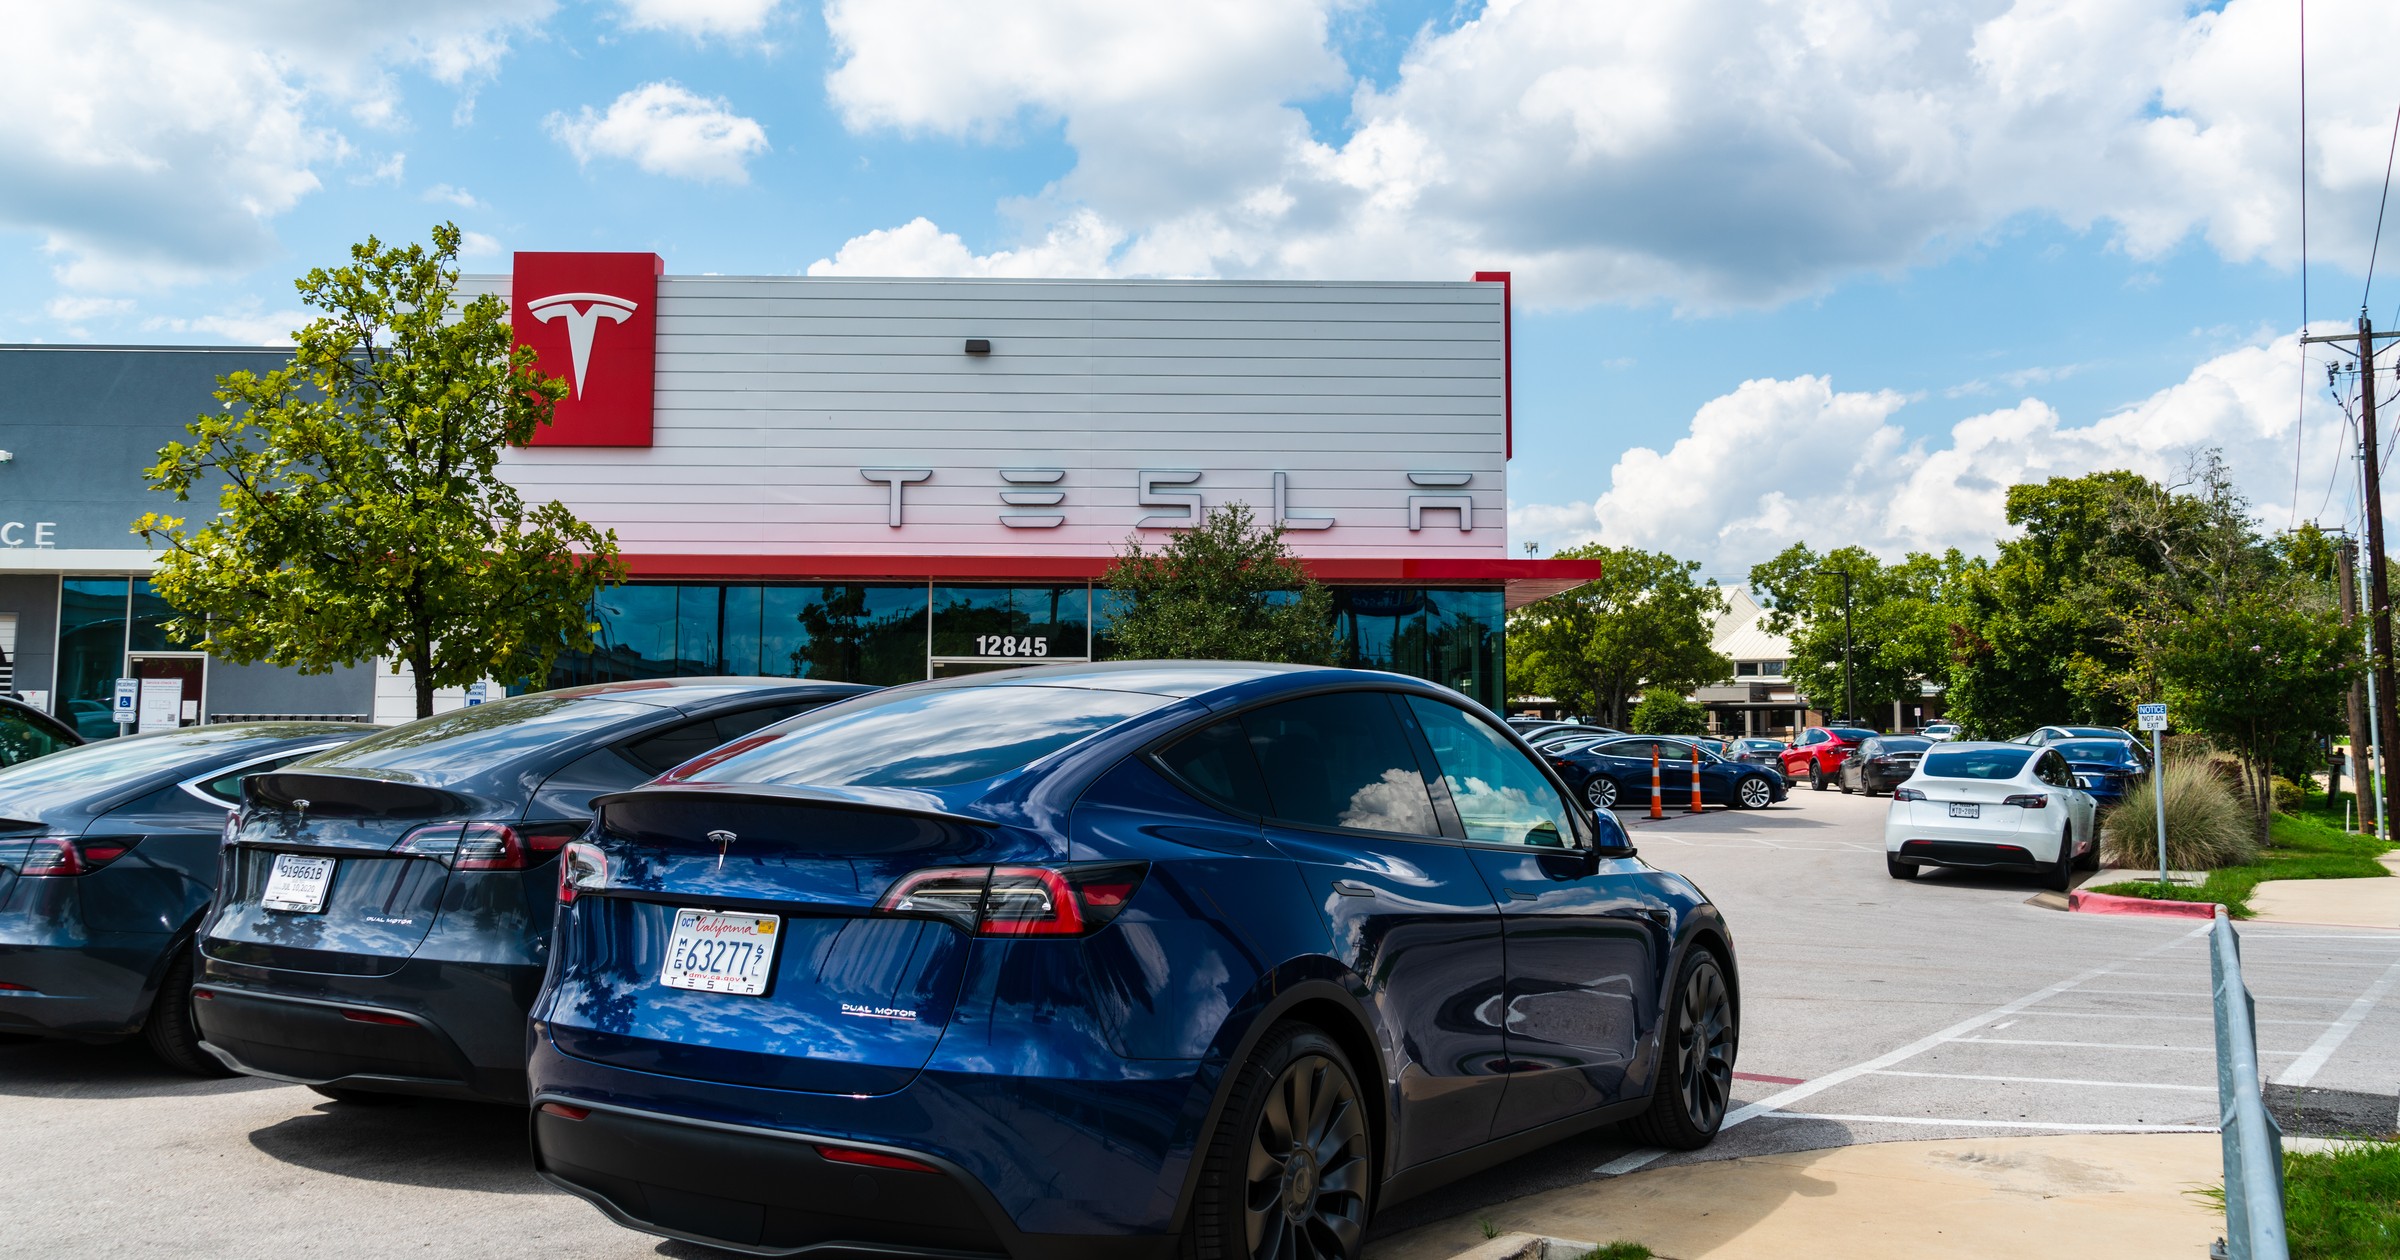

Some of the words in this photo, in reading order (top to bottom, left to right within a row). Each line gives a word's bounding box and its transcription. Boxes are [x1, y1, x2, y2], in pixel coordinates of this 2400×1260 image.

[859, 469, 1473, 532] TESLA
[976, 635, 1047, 657] 12845
[2139, 705, 2165, 714] NOTICE
[281, 865, 323, 880] 919661B
[681, 917, 695, 928] OCT
[696, 916, 757, 938] California
[685, 939, 753, 975] 63277
[670, 976, 755, 993] TESLA
[688, 972, 741, 983] dmv.ca.gov
[841, 1003, 872, 1012] DUAL
[874, 1007, 917, 1018] MOTOR
